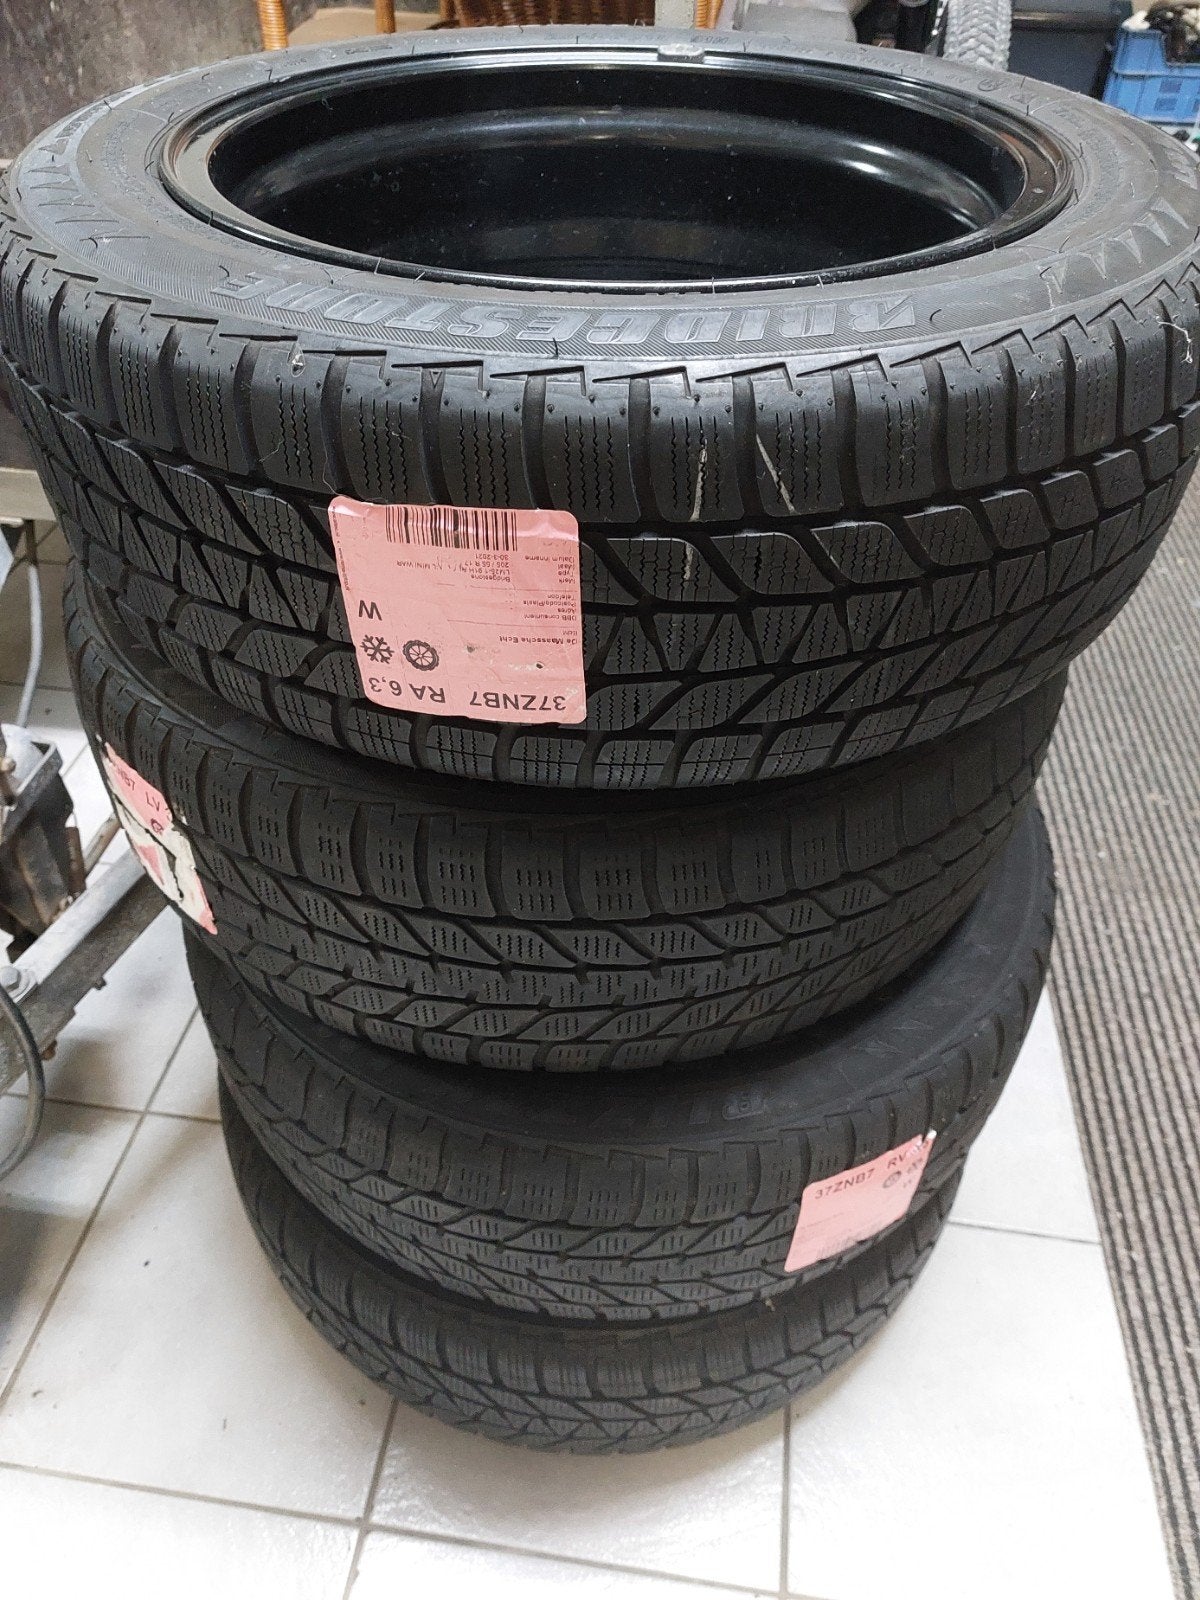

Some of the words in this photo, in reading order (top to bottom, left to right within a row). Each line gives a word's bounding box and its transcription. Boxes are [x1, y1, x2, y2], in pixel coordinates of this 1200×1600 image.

[211, 271, 916, 345] BRIDGESTONE
[358, 600, 383, 621] W
[498, 635, 519, 644] Echt
[368, 677, 402, 697] 6,3
[409, 683, 446, 703] RA
[469, 691, 567, 711] 37ZNB7
[815, 1168, 876, 1200] 37ZNB7
